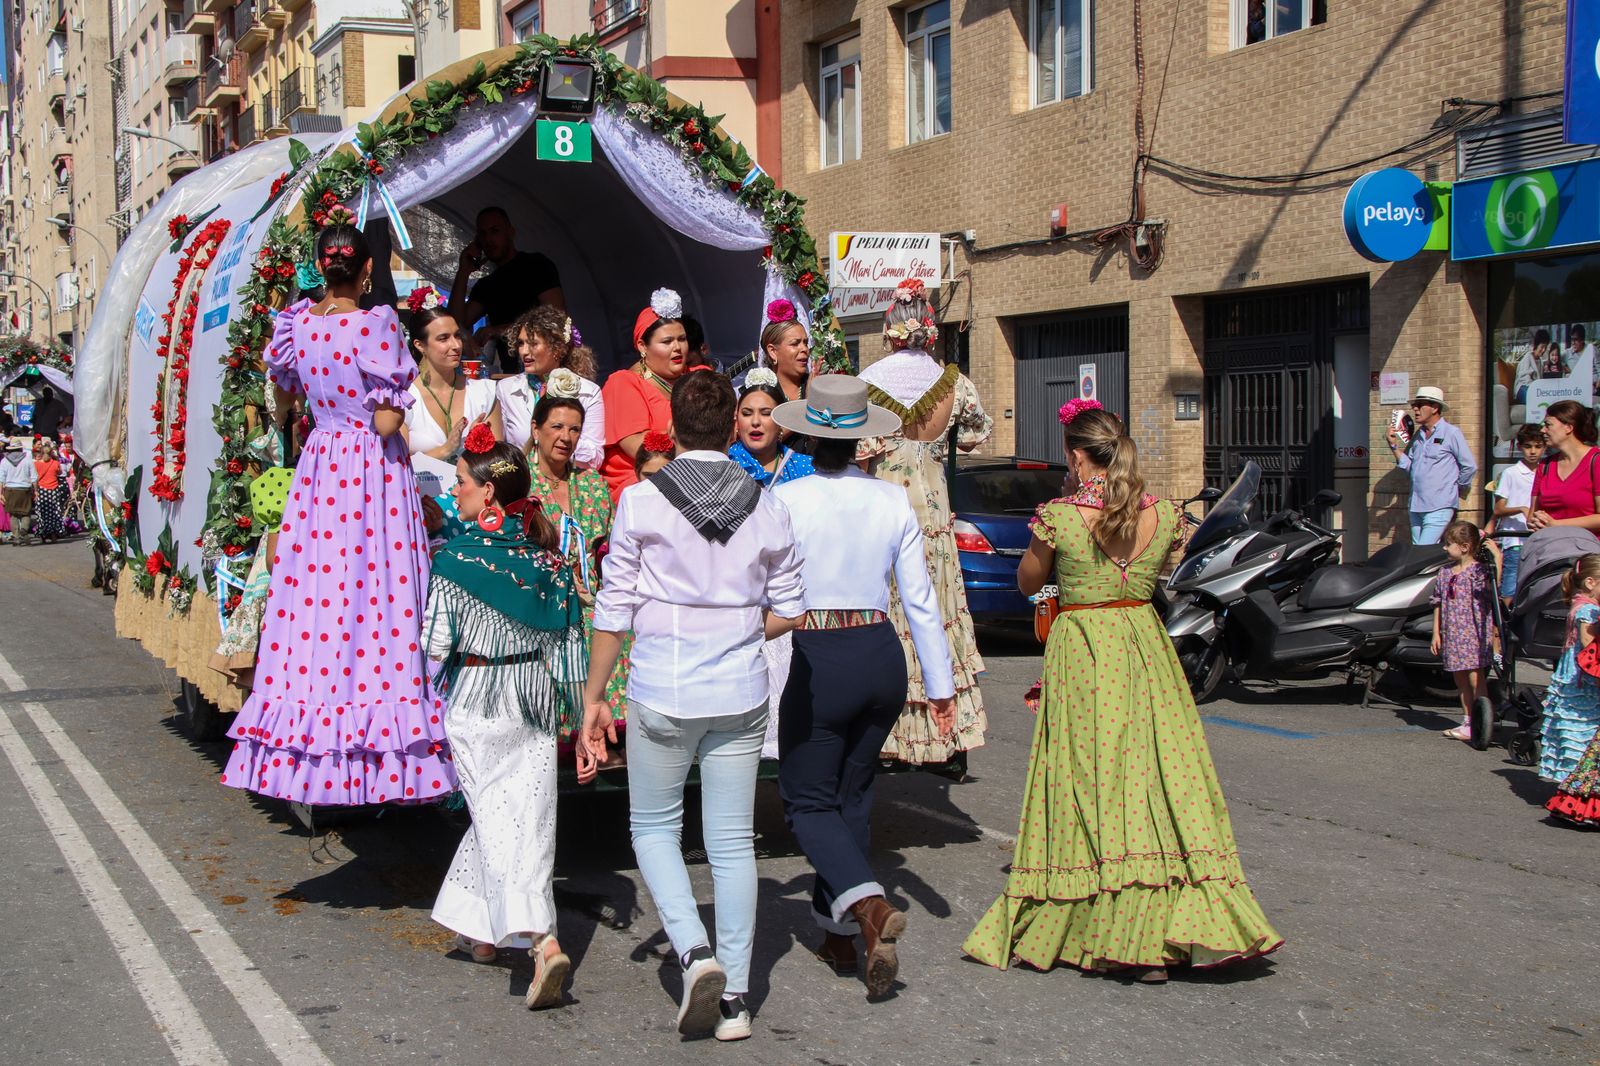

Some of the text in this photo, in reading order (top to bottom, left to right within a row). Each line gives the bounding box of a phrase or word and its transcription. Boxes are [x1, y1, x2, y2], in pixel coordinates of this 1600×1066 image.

[554, 125, 574, 156] 8
[1363, 201, 1425, 226] pelayo
[856, 235, 930, 250] PELUQUERÍA
[844, 257, 871, 282] Mari
[873, 257, 906, 281] Carmen
[907, 257, 936, 279] Estévez
[1536, 387, 1582, 398] Descuento de
